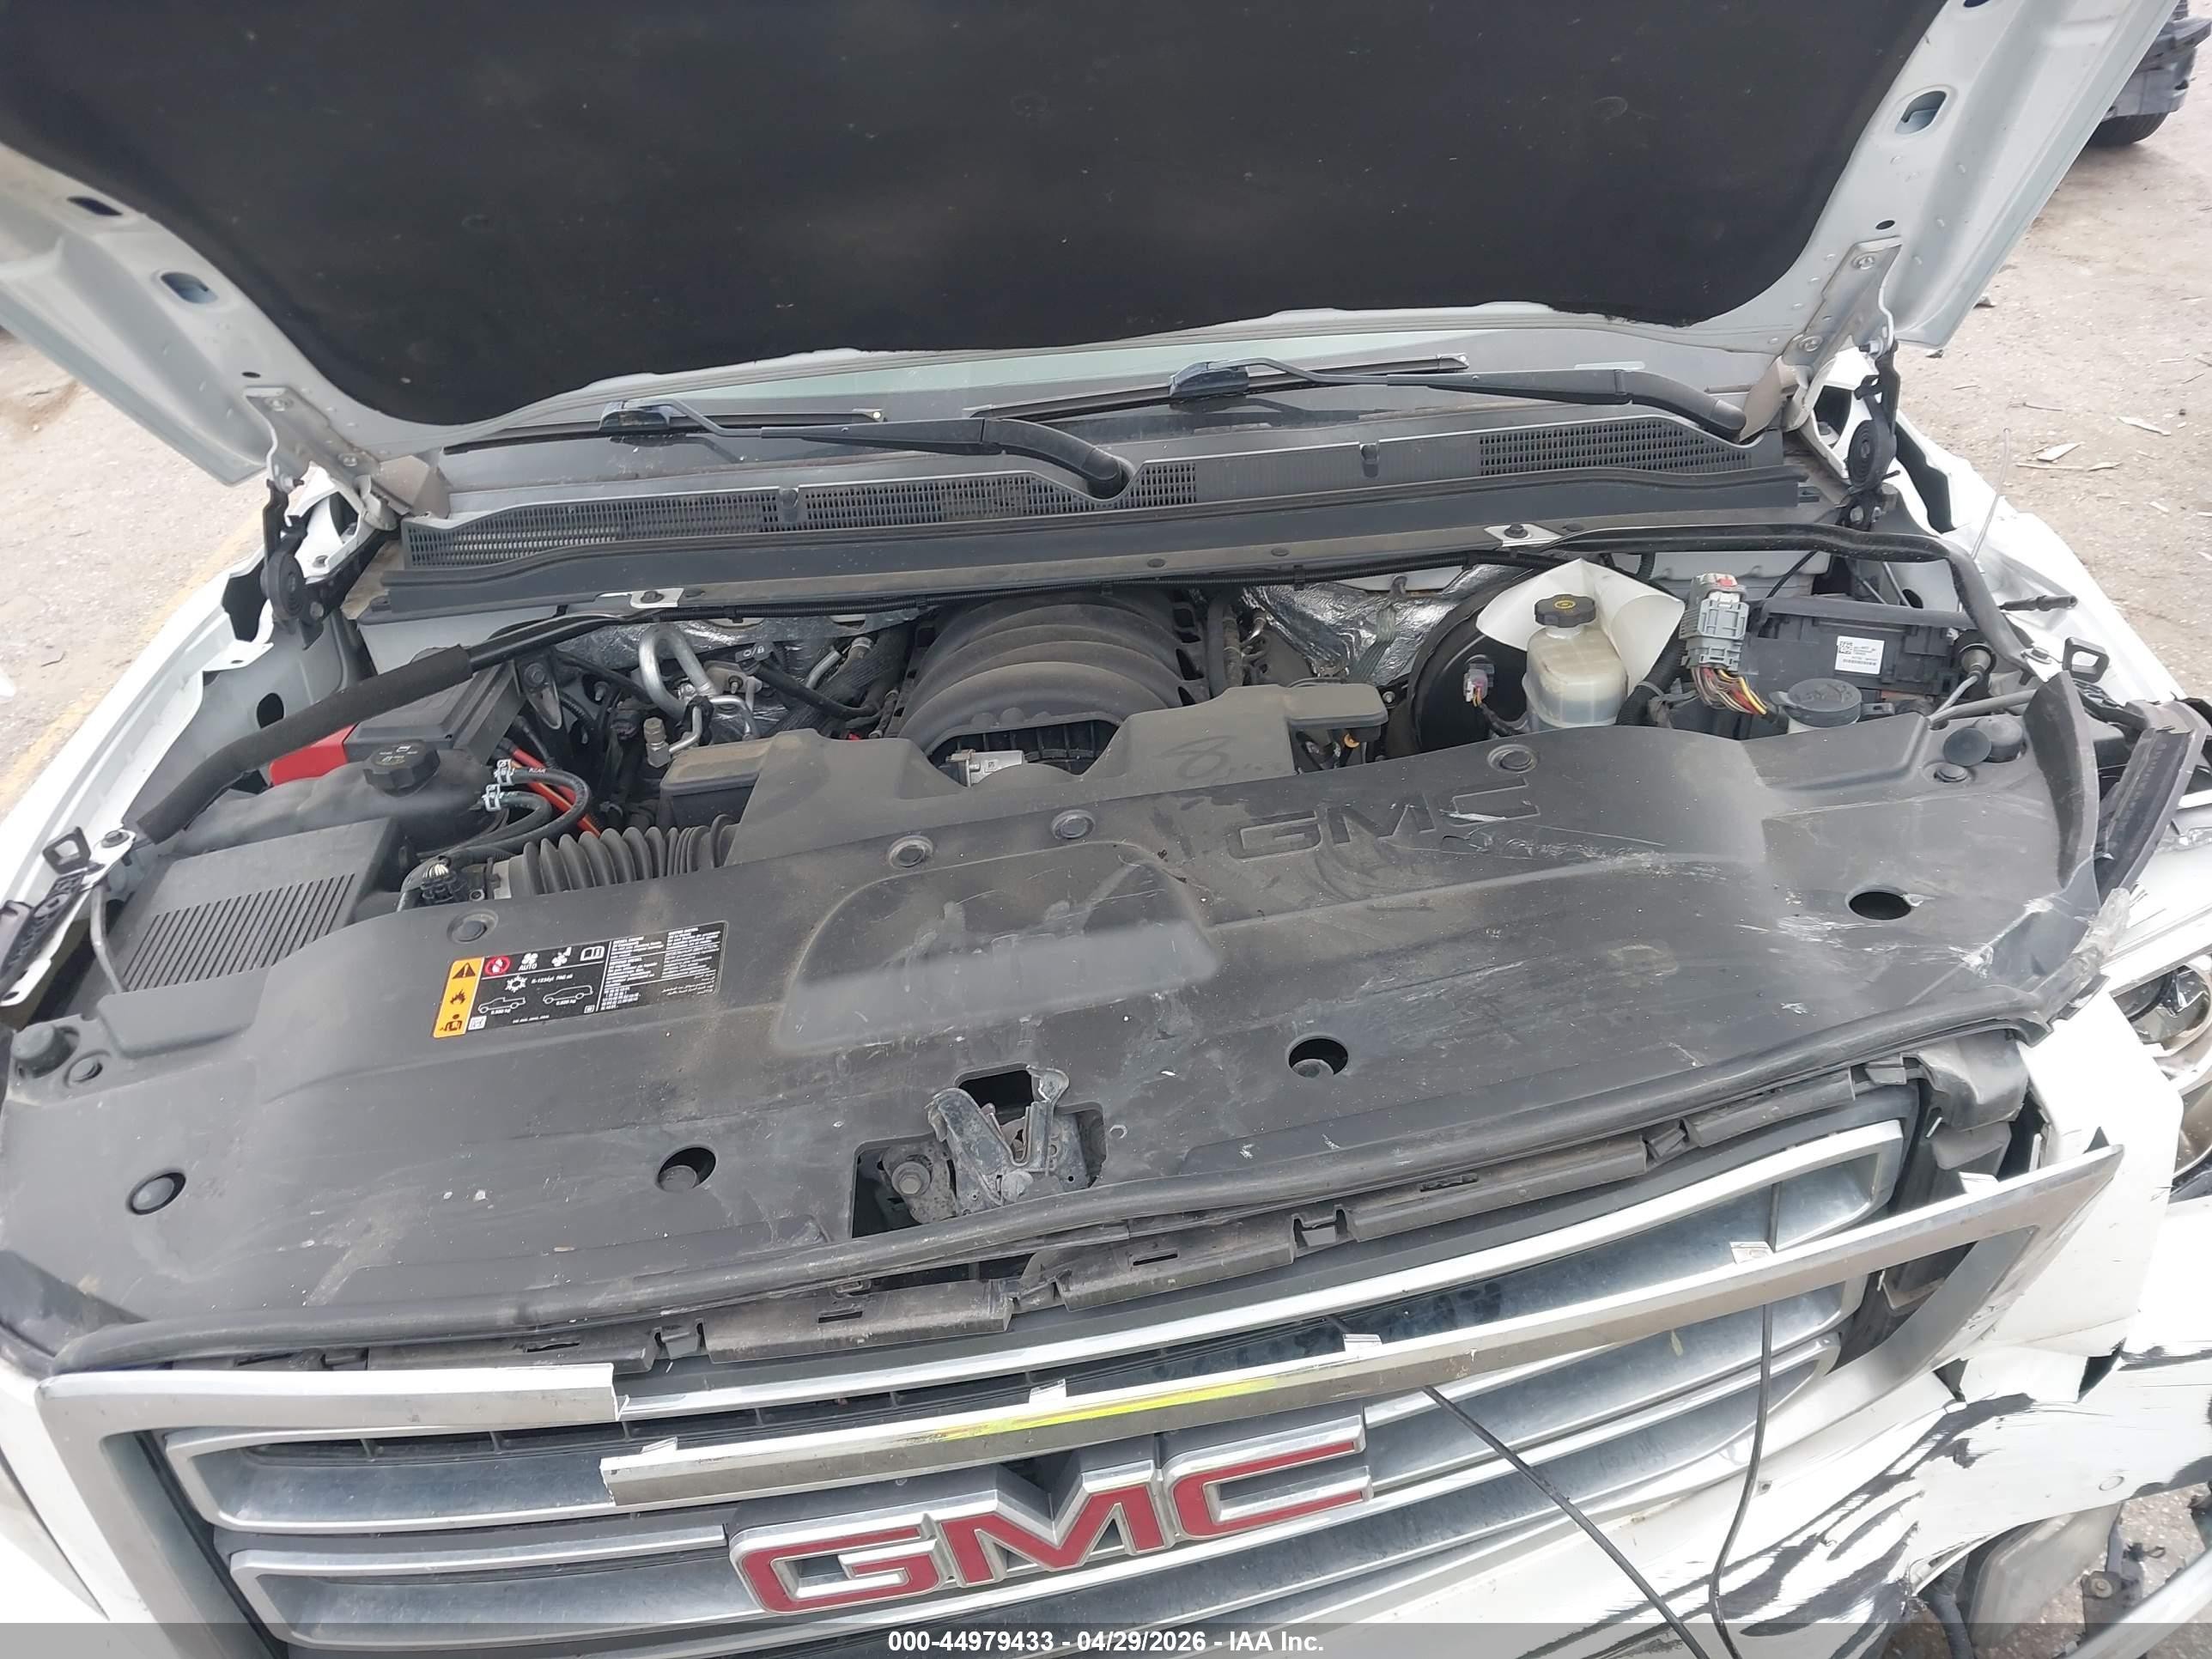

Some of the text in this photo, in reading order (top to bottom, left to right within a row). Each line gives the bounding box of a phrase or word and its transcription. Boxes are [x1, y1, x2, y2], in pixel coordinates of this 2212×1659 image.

[1225, 778, 1540, 862] GMC
[518, 963, 538, 971] AUTO
[730, 1415, 1372, 1614] GMC
